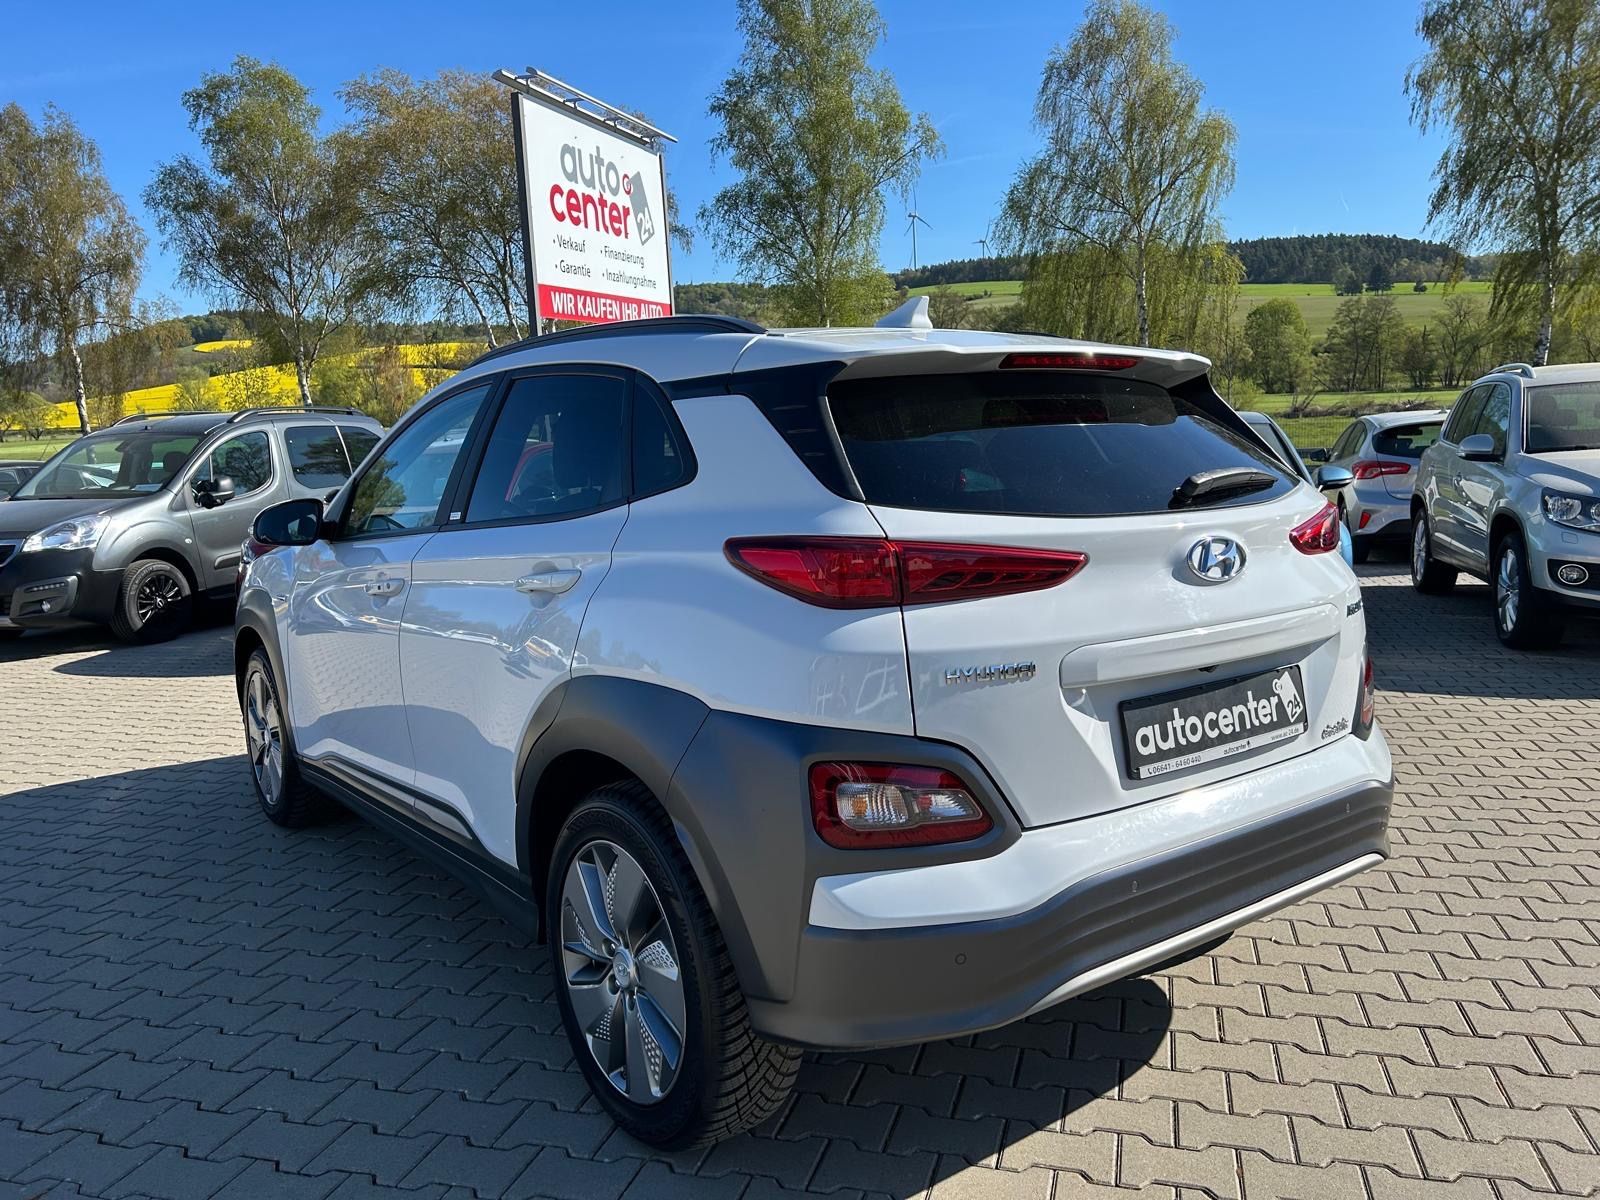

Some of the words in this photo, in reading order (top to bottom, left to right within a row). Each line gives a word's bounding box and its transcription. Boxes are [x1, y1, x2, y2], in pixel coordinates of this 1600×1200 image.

[560, 143, 620, 196] auto
[550, 184, 630, 239] center
[637, 207, 654, 240] 24
[557, 235, 586, 253] Verkauf
[604, 246, 644, 269] Finanzierung
[560, 262, 591, 278] Garantie
[606, 270, 657, 289] Inzahlungnahme
[551, 292, 575, 315] WIR
[577, 294, 619, 320] KAUFEN
[622, 301, 638, 320] IHR
[640, 303, 663, 319] AUTO
[945, 661, 1035, 683] HYUNDAI
[1135, 691, 1279, 756] autocenter
[1287, 694, 1301, 719] 24
[1223, 743, 1248, 755] autocenter
